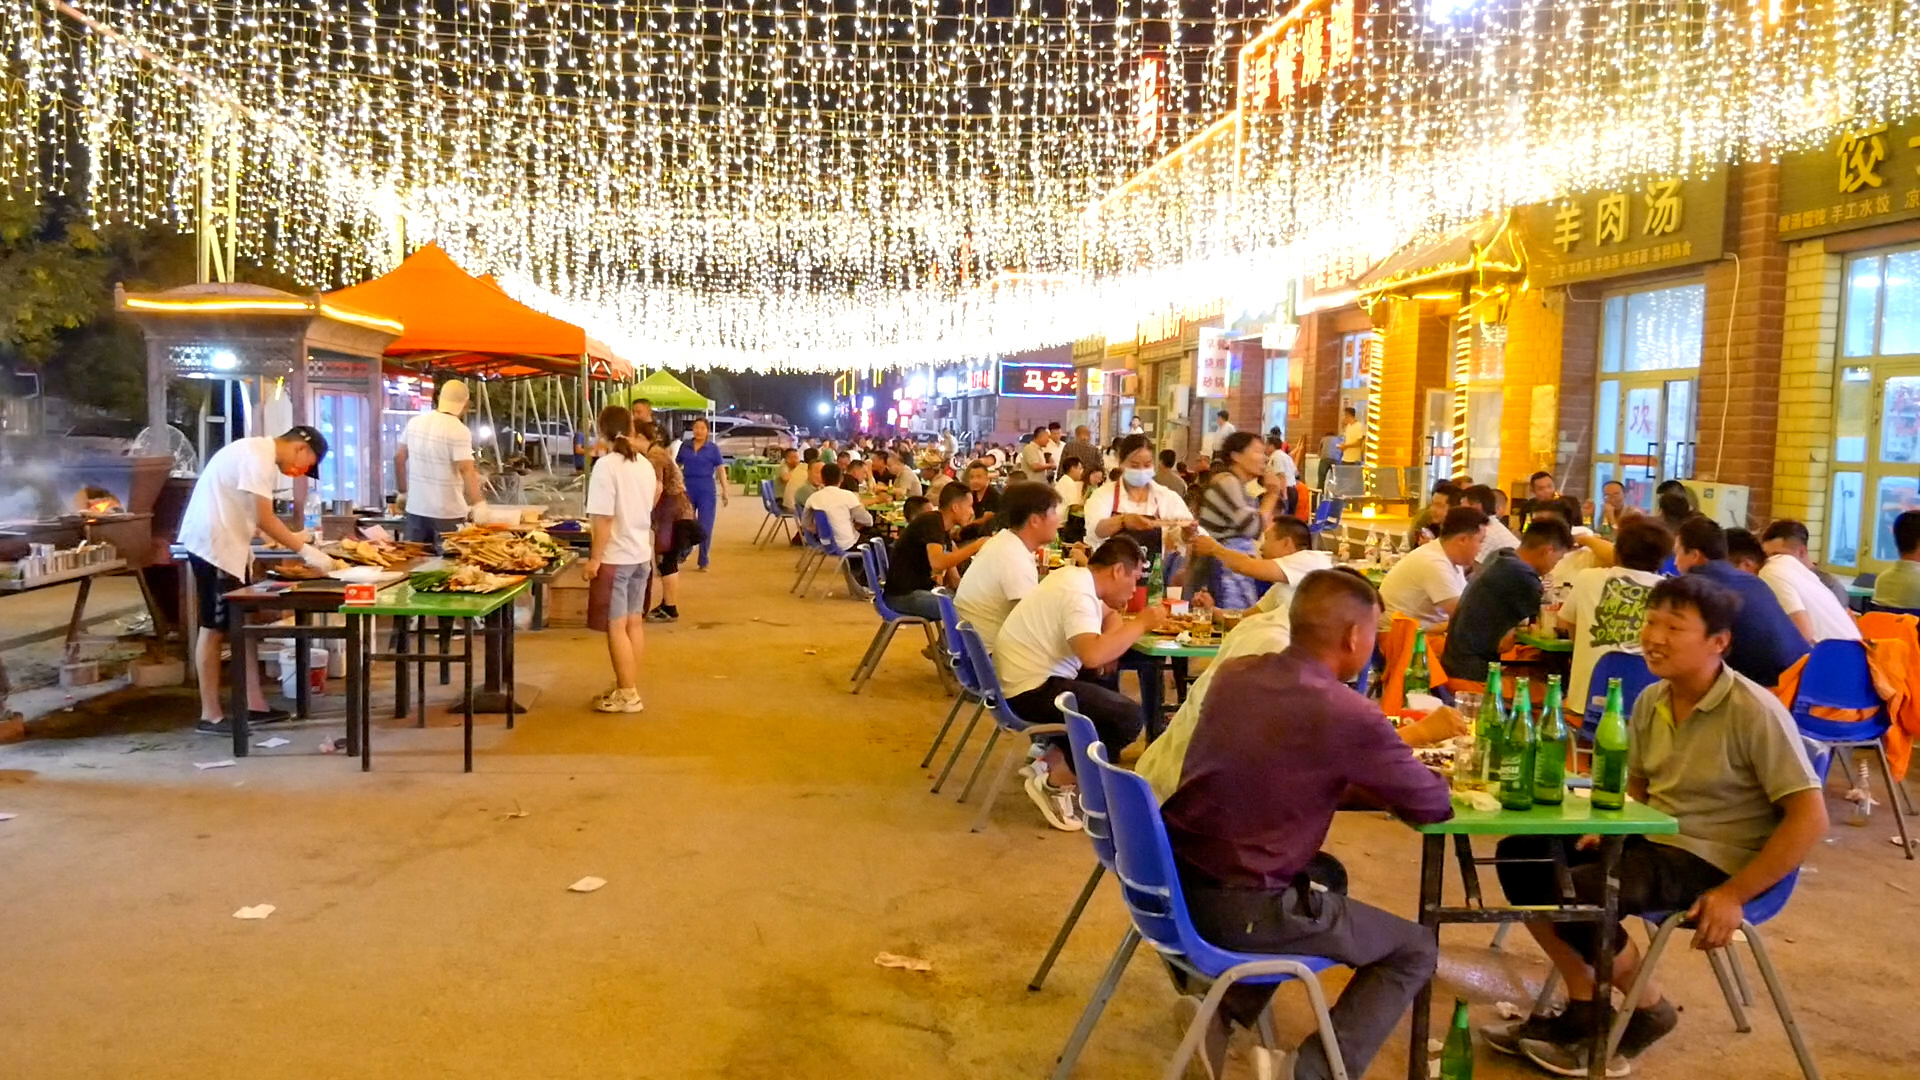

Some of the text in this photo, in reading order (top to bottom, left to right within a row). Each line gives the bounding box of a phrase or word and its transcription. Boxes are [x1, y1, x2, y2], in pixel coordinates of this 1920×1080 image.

[1837, 122, 1920, 193] 饺
[1553, 178, 1683, 252] 羊肉汤
[1831, 194, 1890, 223] 手工水饺
[1629, 398, 1651, 435] 欢
